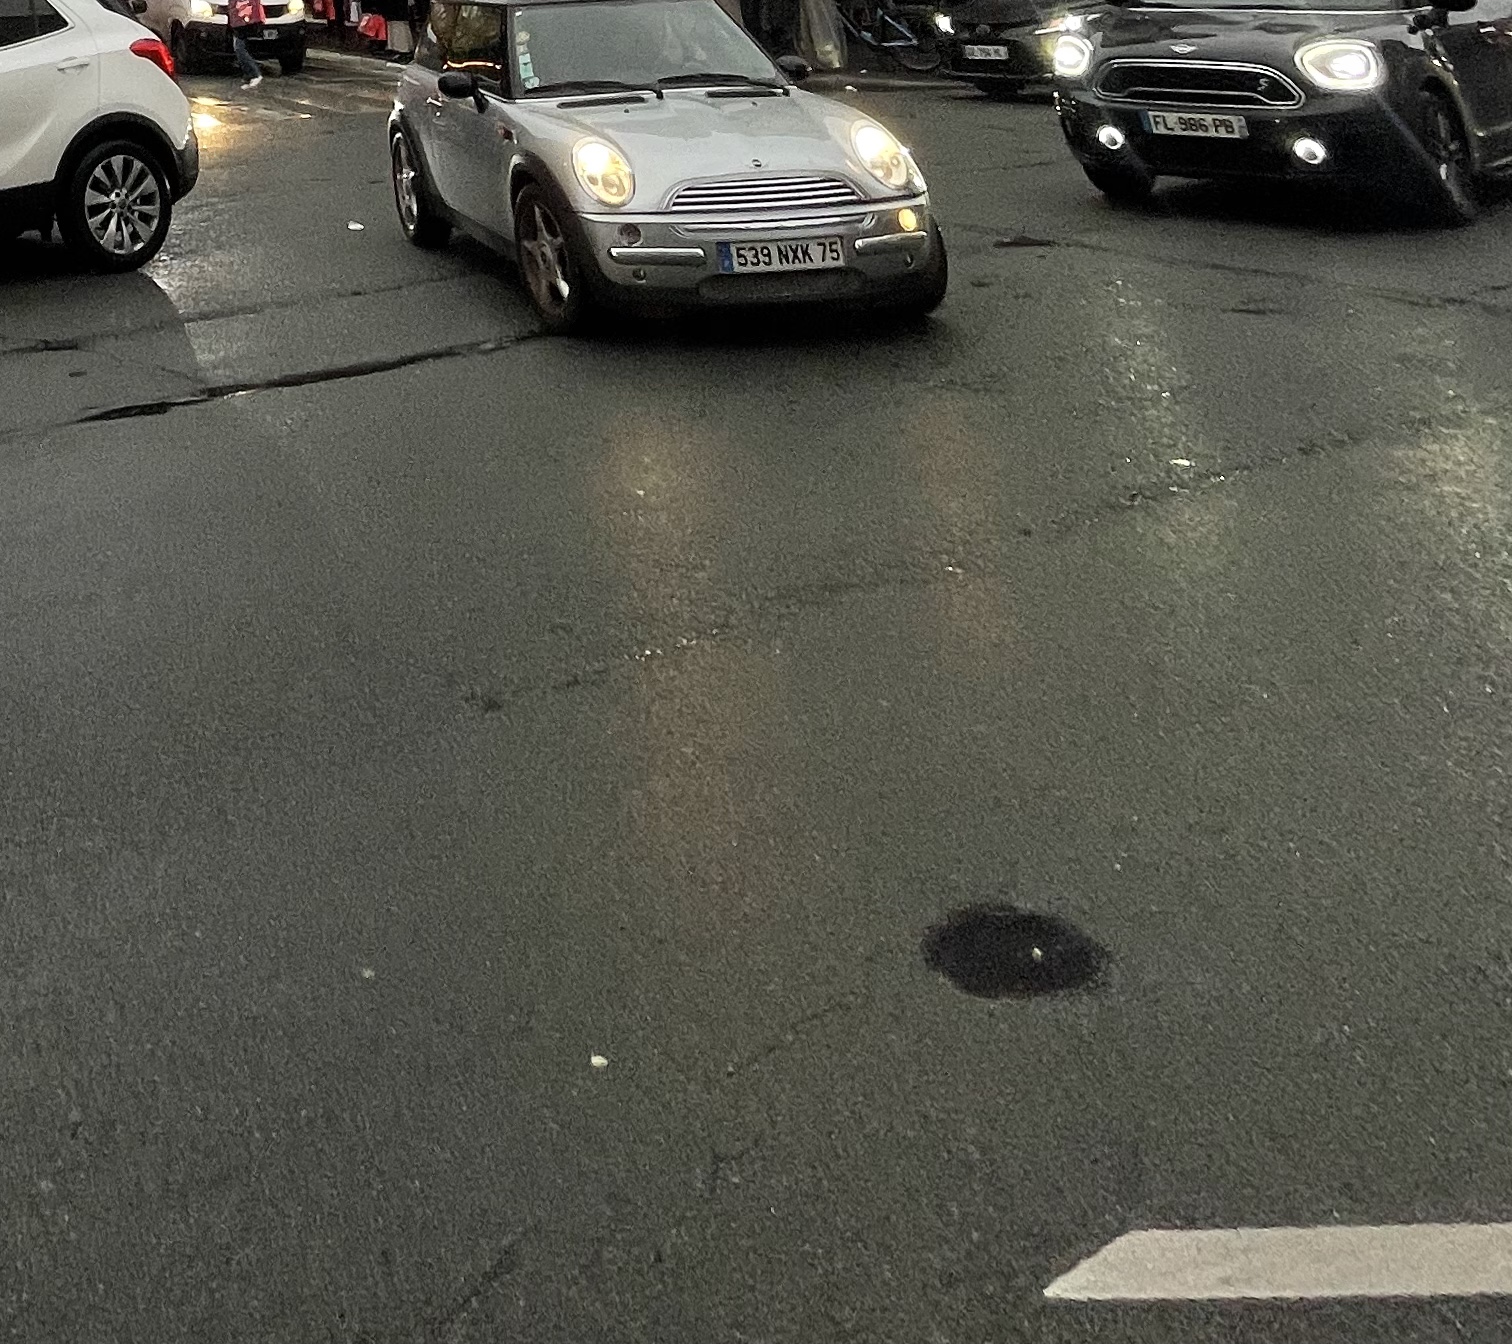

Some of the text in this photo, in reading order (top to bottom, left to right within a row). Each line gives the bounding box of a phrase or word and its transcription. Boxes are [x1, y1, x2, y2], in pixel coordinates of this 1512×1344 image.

[735, 240, 840, 268] 539 NXK 75
